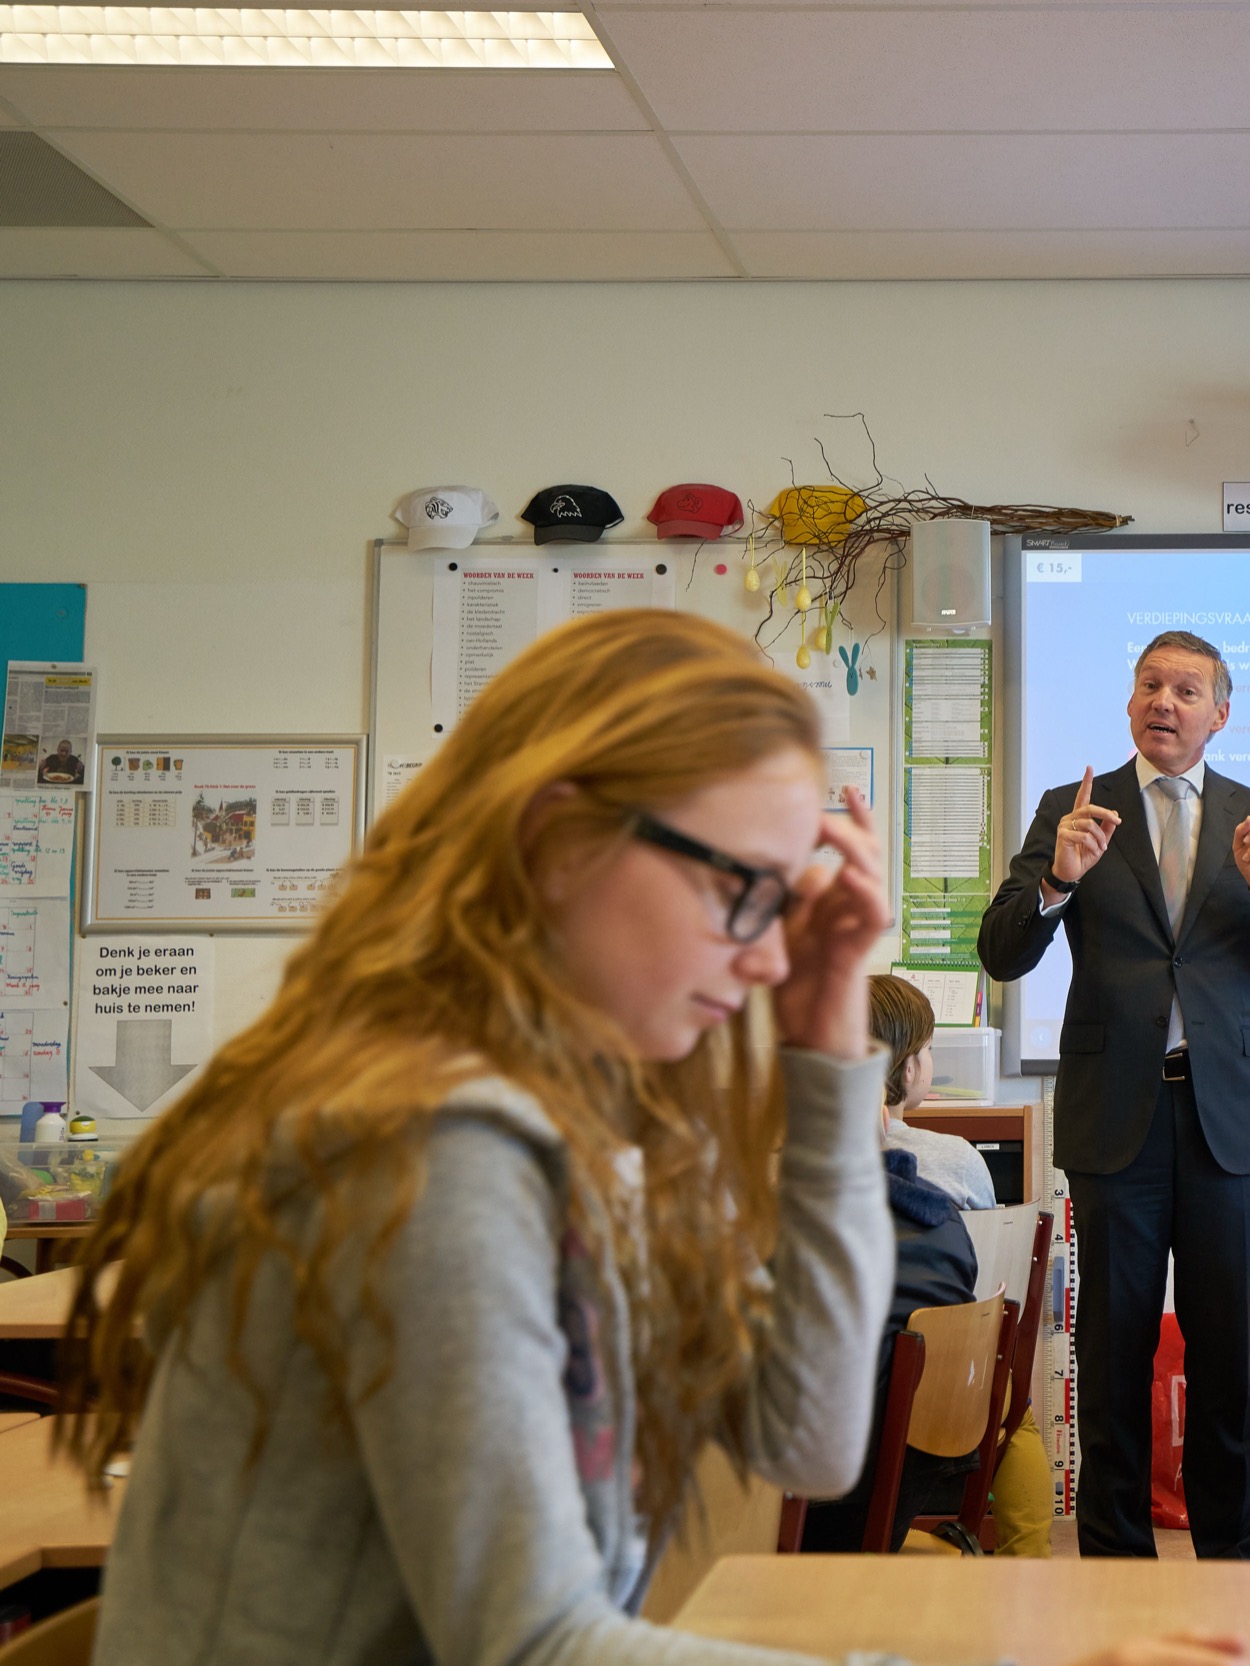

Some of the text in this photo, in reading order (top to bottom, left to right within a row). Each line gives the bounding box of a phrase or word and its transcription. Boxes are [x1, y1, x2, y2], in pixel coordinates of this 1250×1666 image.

[1026, 539, 1051, 547] SMART
[1049, 562, 1072, 574] 15,-
[1204, 750, 1226, 762] ank
[100, 946, 194, 960] Denk je eraan
[95, 964, 197, 979] om je beker en
[93, 984, 199, 998] bakje mee naar
[95, 1001, 195, 1014] huis te nemen!
[1054, 1234, 1064, 1242] 4
[1054, 1323, 1064, 1332] 6
[1054, 1460, 1064, 1468] 9
[1054, 1499, 1064, 1515] 10
